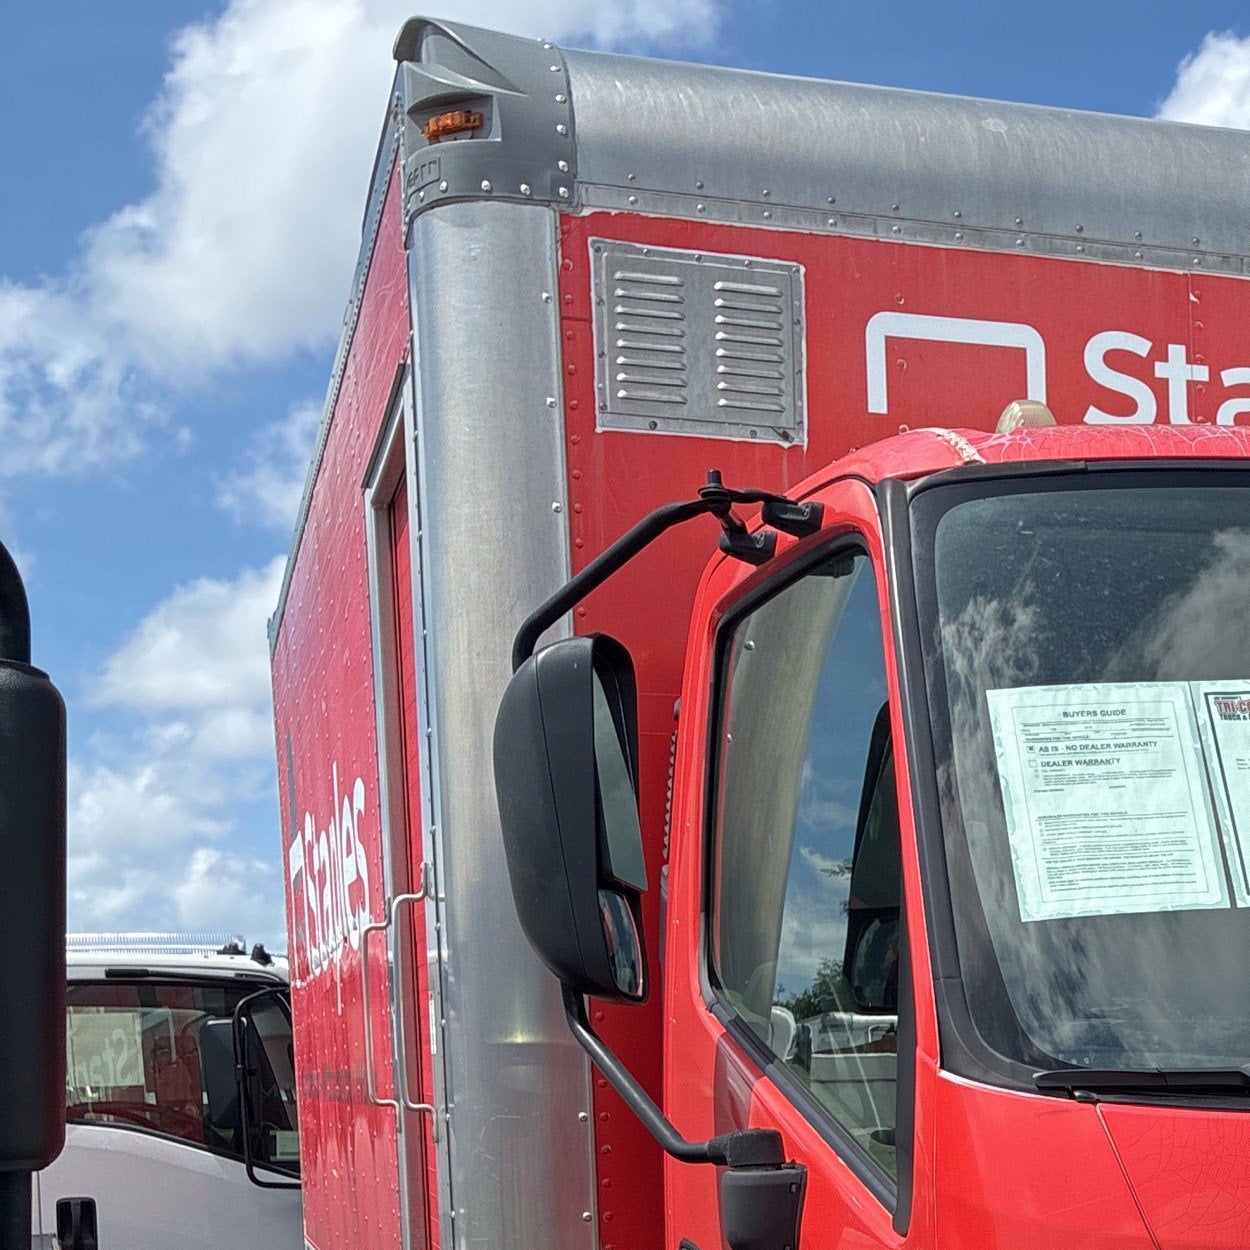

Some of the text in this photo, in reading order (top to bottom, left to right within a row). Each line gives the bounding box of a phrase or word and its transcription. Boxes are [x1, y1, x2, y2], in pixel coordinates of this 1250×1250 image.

[1062, 708, 1127, 719] BUYERS GUIDE
[1079, 742, 1112, 751] DEALER
[1112, 740, 1158, 750] WARRANTY
[1040, 757, 1122, 768] DEALER WARRANTY
